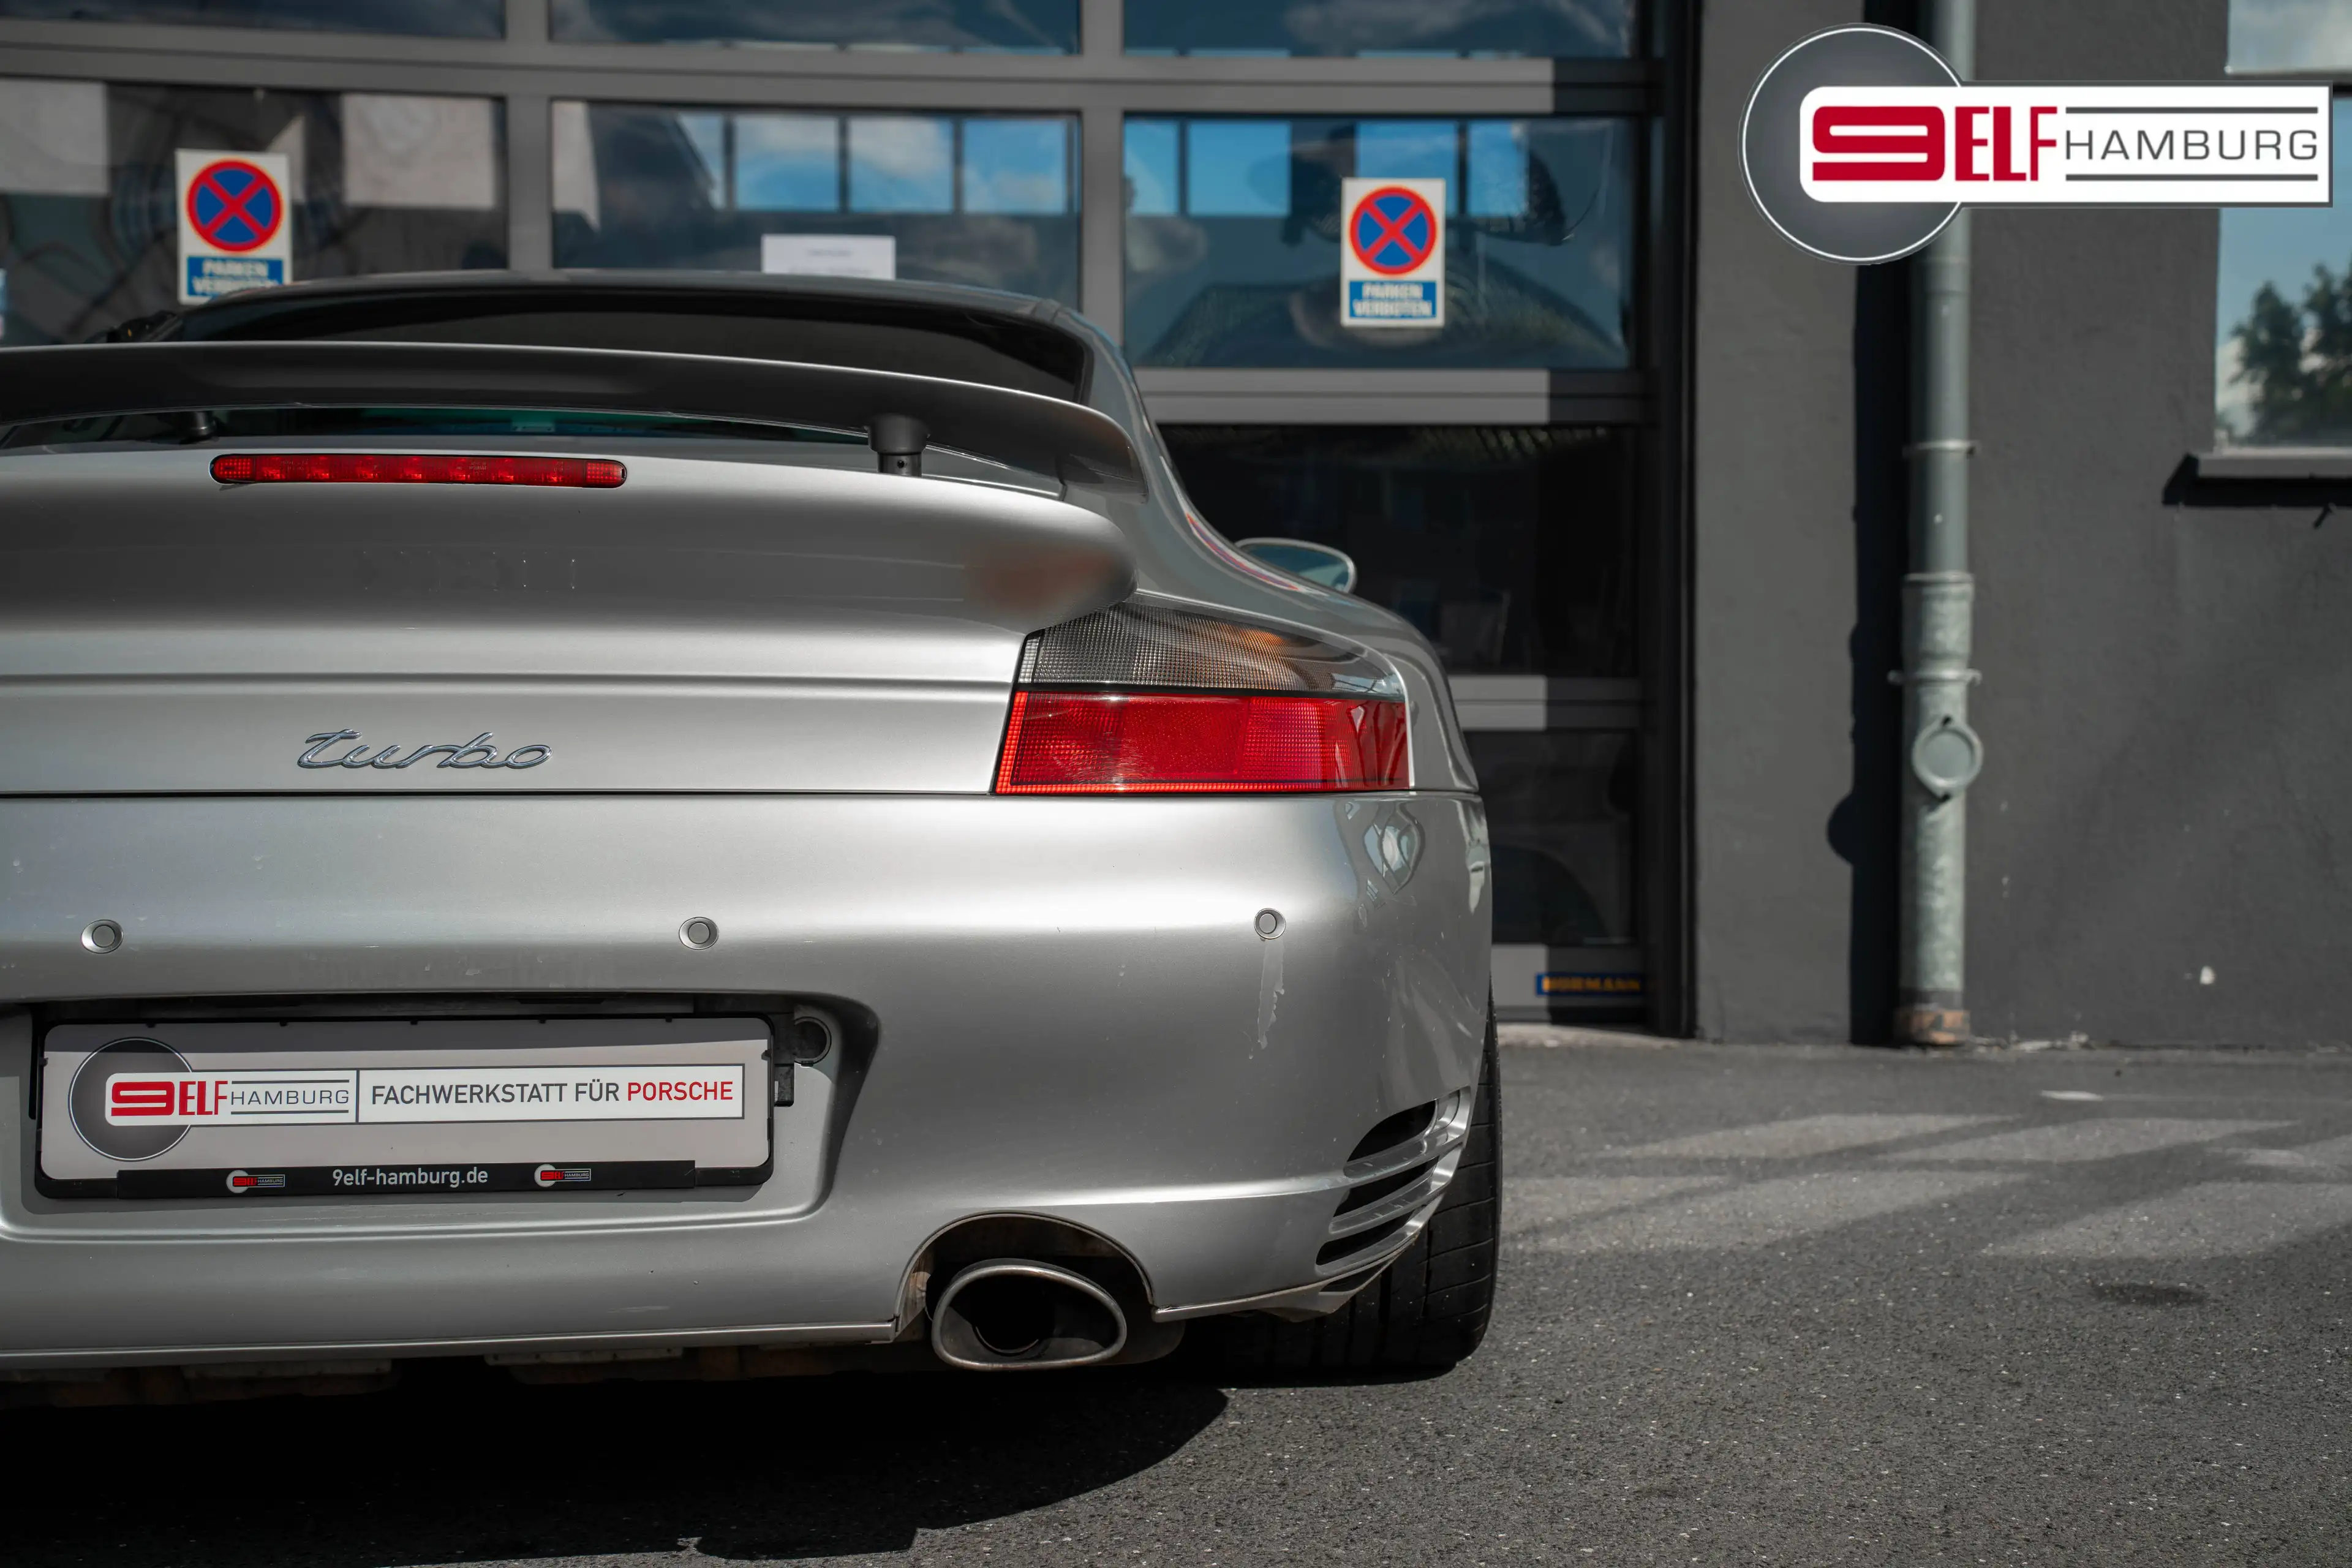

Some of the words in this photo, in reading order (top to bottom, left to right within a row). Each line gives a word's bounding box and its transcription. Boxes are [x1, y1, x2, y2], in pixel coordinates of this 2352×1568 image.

[297, 729, 553, 769] turbo
[110, 1080, 228, 1117] 9ELF
[230, 1089, 350, 1106] HAMBURG
[371, 1082, 568, 1105] FACHWERKSTATT
[575, 1079, 620, 1102] FÜR
[627, 1080, 734, 1101] PORSCHE
[331, 1166, 489, 1189] 9elf-hamburg.de
